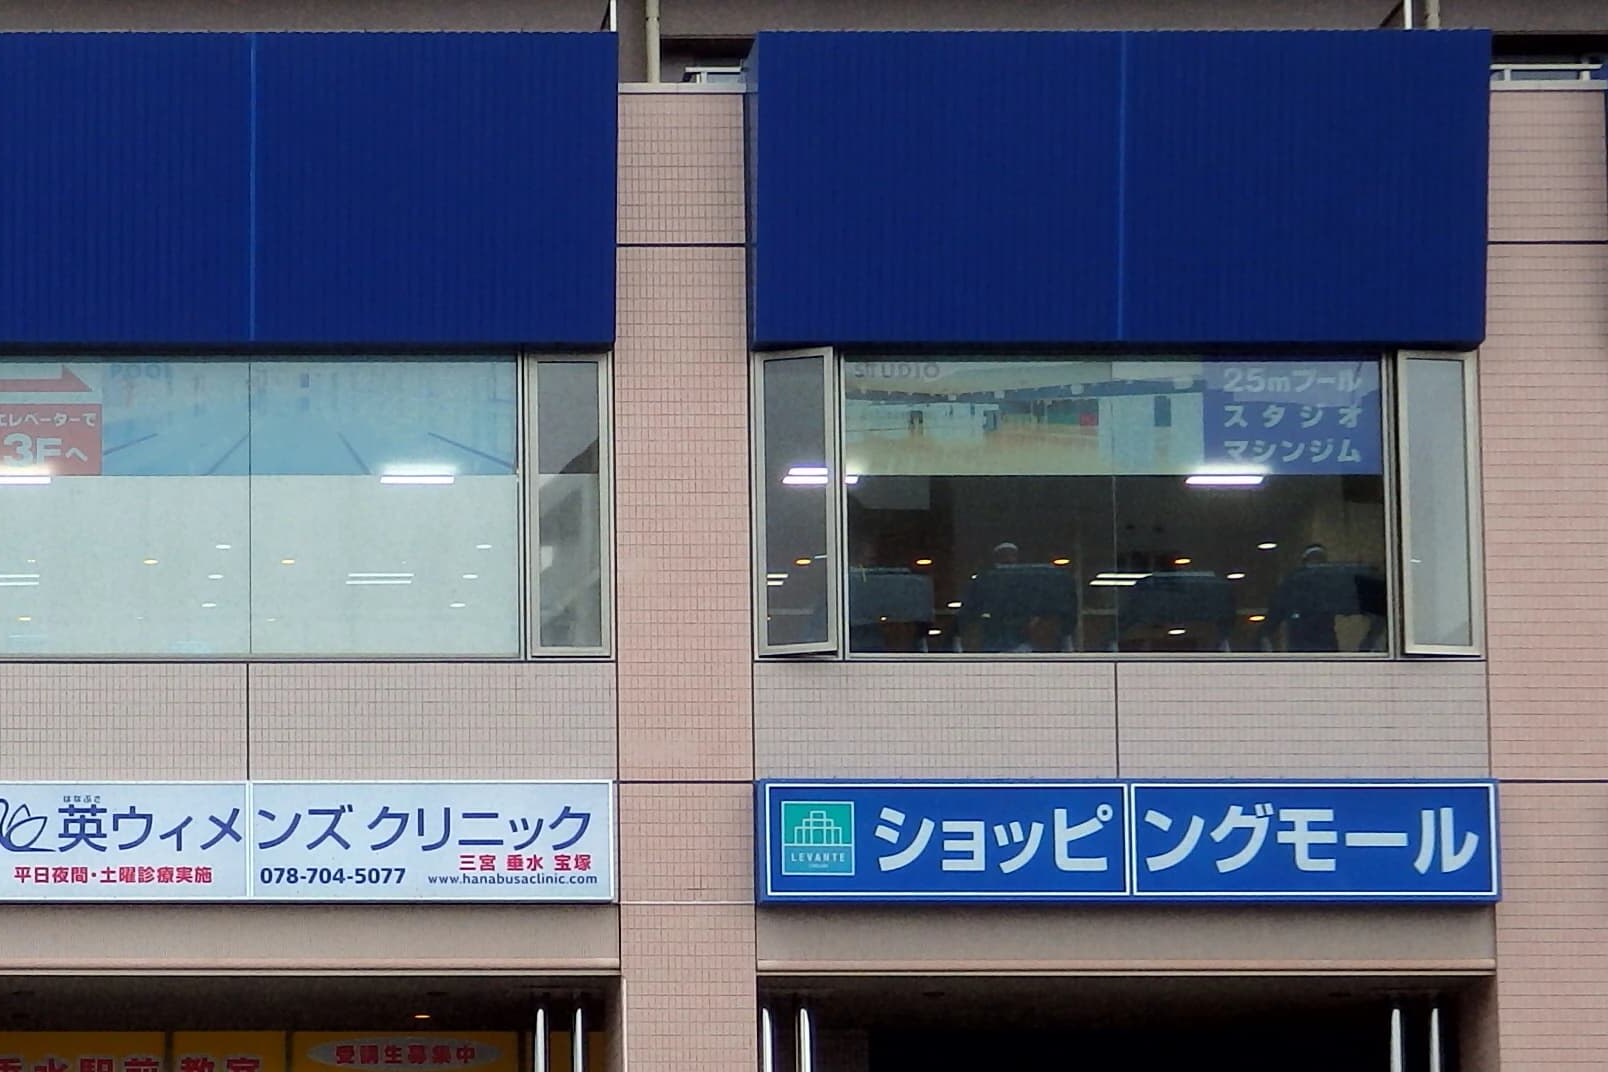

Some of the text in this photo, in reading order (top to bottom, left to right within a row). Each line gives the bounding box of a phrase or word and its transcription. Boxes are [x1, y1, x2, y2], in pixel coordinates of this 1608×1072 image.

[1224, 404, 1362, 428] スタジオ
[1224, 439, 1361, 463] マシンジム
[873, 802, 1480, 874] ショッピングモール
[459, 855, 592, 871] 三宮 垂水 宝塚
[791, 852, 846, 862] LEVANTE
[260, 867, 407, 885] 078-704-5077
[428, 872, 598, 885] www.hanabusaclinic.com
[335, 1045, 476, 1064] 受講生募集中
